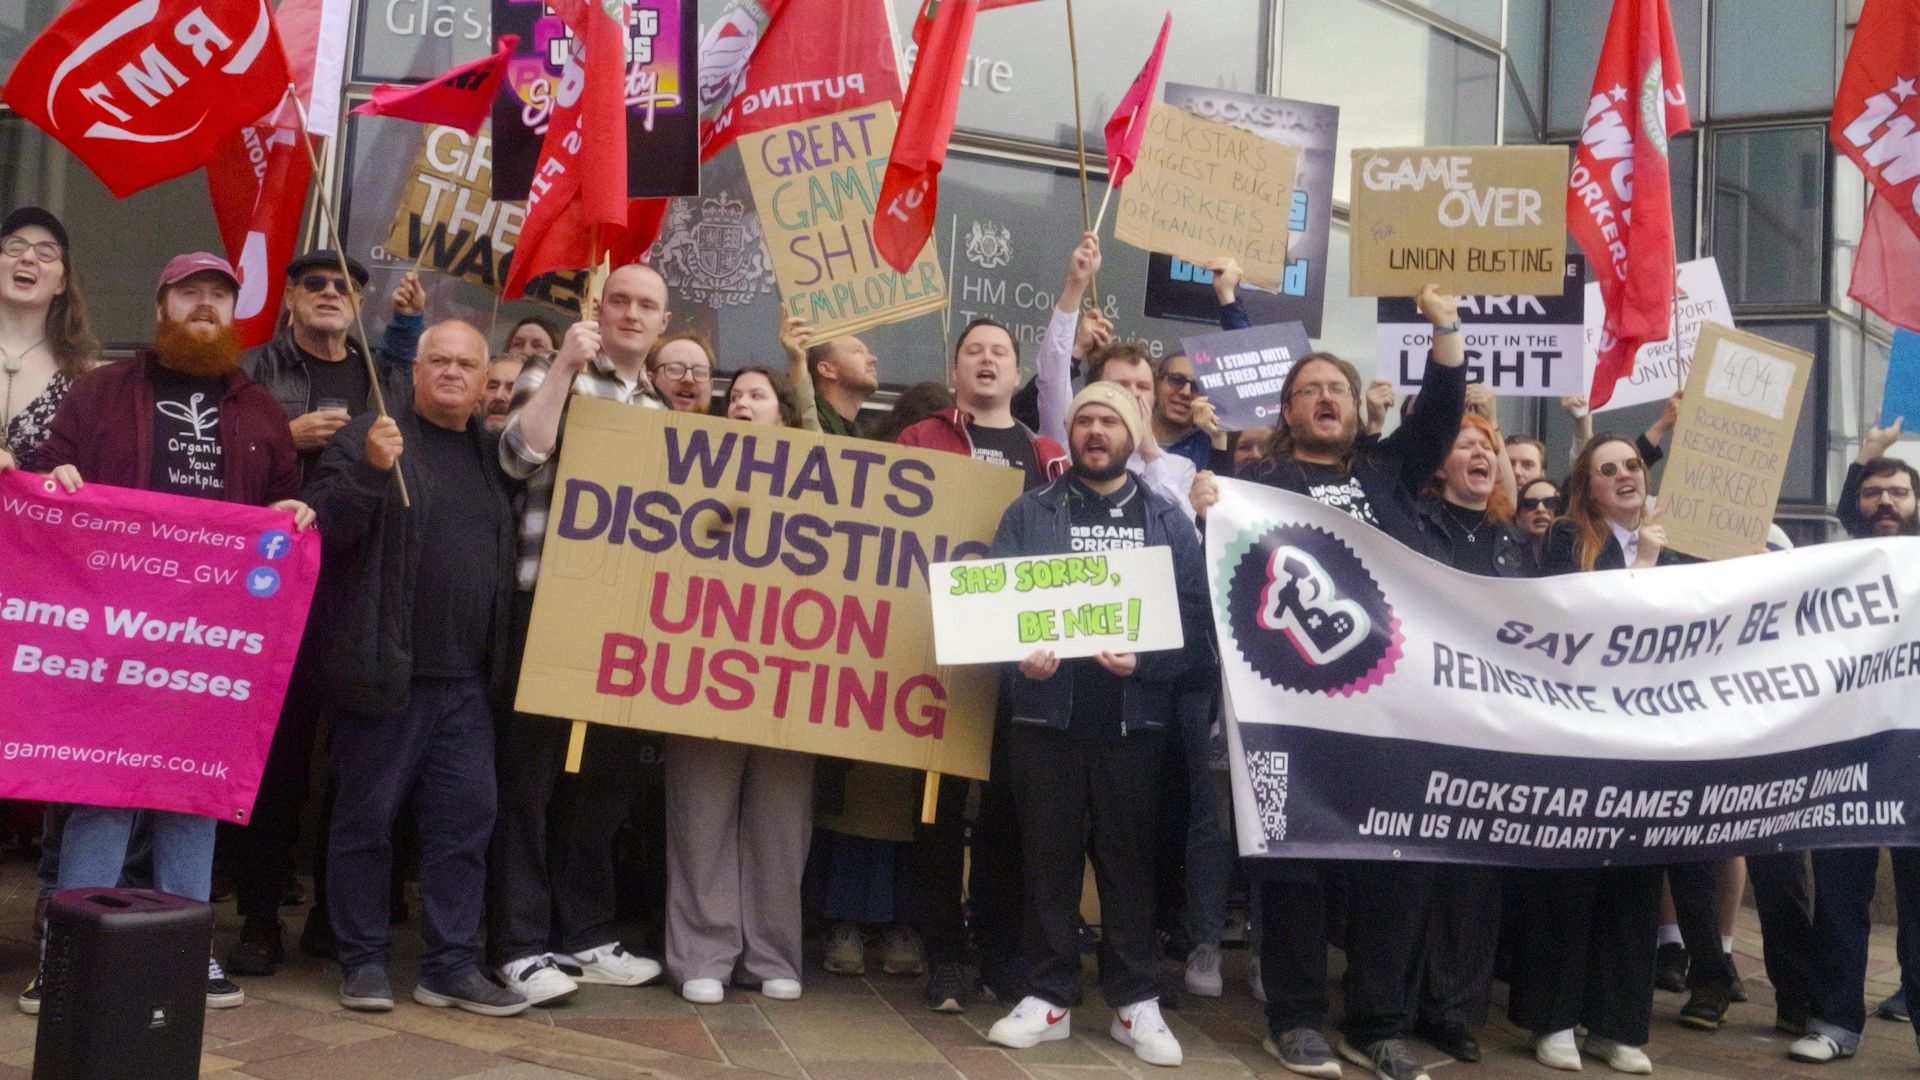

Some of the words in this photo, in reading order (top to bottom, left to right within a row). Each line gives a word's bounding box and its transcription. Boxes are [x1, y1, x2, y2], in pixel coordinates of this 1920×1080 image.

[386, 0, 493, 46] Glas
[762, 113, 876, 178] GREAT
[1146, 111, 1267, 172] OCKSTARS
[1232, 171, 1287, 207] BUG?
[1362, 155, 1474, 192] GAME
[1138, 167, 1264, 234] WORKERS
[1438, 186, 1542, 228] OVER
[790, 218, 881, 286] SHI
[1389, 247, 1455, 271] UNION
[1467, 247, 1553, 273] BUSTING
[788, 261, 944, 326] EMPLOYER
[962, 276, 1006, 305] HM
[1103, 294, 1121, 321] &
[1216, 356, 1224, 371] I
[1223, 350, 1261, 370] STAND
[1259, 346, 1291, 363] WITH
[1465, 335, 1499, 347] OUT
[1504, 335, 1520, 347] IN
[1526, 335, 1558, 348] THE
[1199, 372, 1225, 389] THE
[1223, 366, 1259, 386] FIRED
[1400, 350, 1563, 388] LGHT
[1723, 349, 1776, 400] 404
[168, 437, 222, 456] Organis
[188, 456, 216, 471] Your
[1682, 428, 1749, 464] RESPECT
[1751, 450, 1778, 474] FOR
[663, 426, 936, 518] WHATS
[1684, 456, 1769, 509] WORKERS
[3, 495, 64, 525] WGB
[71, 512, 141, 535] Game
[150, 522, 246, 551] Workers
[1091, 524, 1145, 541] GAME
[1666, 491, 1704, 525] NOT
[1708, 503, 1765, 545] FOUND
[86, 550, 239, 585] @IWGB_GW
[950, 562, 1006, 596] SAY
[1014, 555, 1121, 592] SORRY,
[0, 594, 90, 630] ame
[104, 606, 265, 655] Workers
[649, 570, 891, 660] UNION
[1018, 609, 1059, 643] BE
[1496, 620, 1595, 667] SAY
[1600, 614, 1732, 667] SORRY,
[1736, 600, 1788, 647] BE
[1795, 574, 1900, 637] NICE!
[12, 644, 108, 683] Beat
[116, 659, 251, 701] Bosses
[595, 631, 949, 741] BUSTING
[1433, 641, 1608, 715] REINSTATE
[1611, 679, 1709, 717] YOUR
[1709, 662, 1821, 707] FIRED
[1825, 640, 1920, 695] WORKER
[3, 741, 229, 779] gameworkers.co.uk
[1425, 770, 1589, 818] ROCKSTAR
[1594, 785, 1694, 819] GAMES
[1698, 776, 1809, 817] WORKERS
[1809, 762, 1869, 800] UNION
[1358, 807, 1414, 837] JOIN
[1419, 814, 1451, 839] US
[1456, 817, 1484, 841] IN
[1489, 818, 1625, 849] SOLIDARITY
[1643, 800, 1906, 848] WWW.GAMEWORKERS.CO.UK
